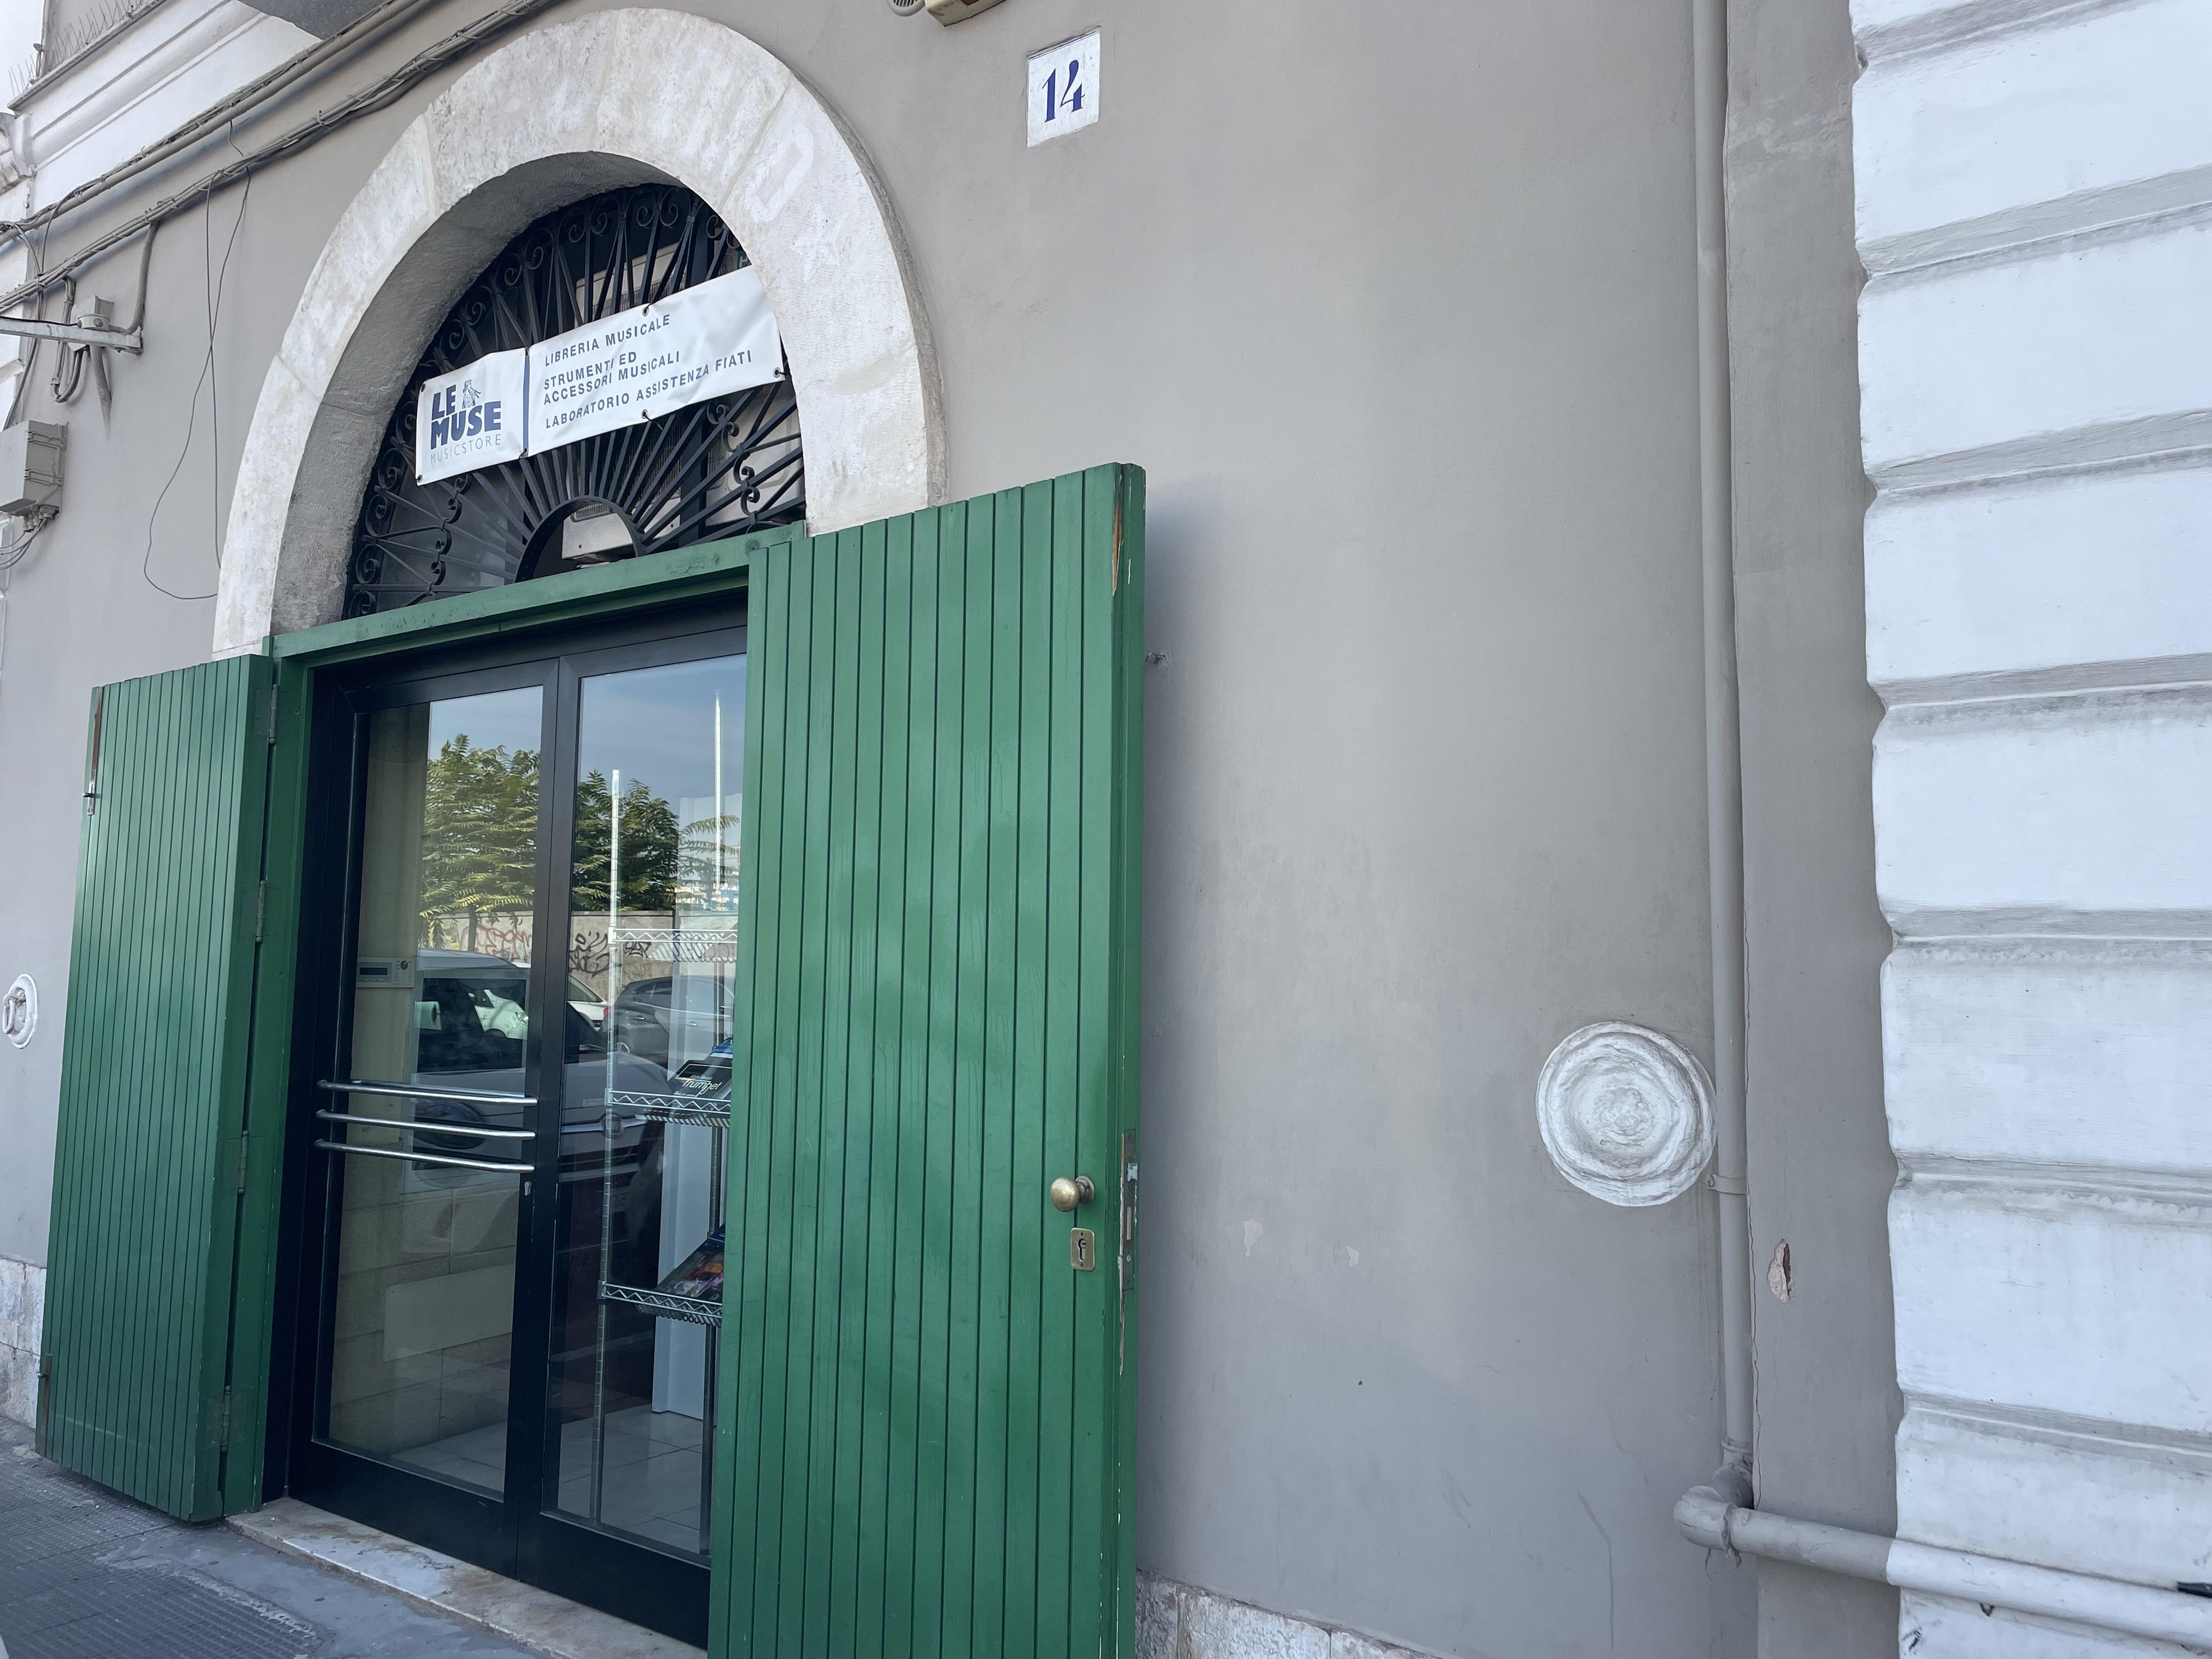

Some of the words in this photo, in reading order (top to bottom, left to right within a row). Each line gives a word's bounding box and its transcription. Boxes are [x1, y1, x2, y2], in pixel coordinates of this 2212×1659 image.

[1042, 59, 1085, 123] 14
[545, 338, 600, 366] LIBRERIA
[606, 314, 670, 346] MUSICALE
[544, 360, 614, 390] STRUMENTI
[619, 352, 636, 365] ED
[544, 373, 612, 405] ACCESSORI
[619, 351, 680, 380] MUSICALI
[546, 389, 629, 429] LABORATORIO
[636, 364, 709, 402] ASSISTENZA
[715, 349, 752, 371] FIATI
[431, 385, 456, 421] LE
[431, 401, 501, 450] MUSE
[431, 434, 501, 465] MUSICSTORE
[682, 1079, 723, 1097] Trumpet
